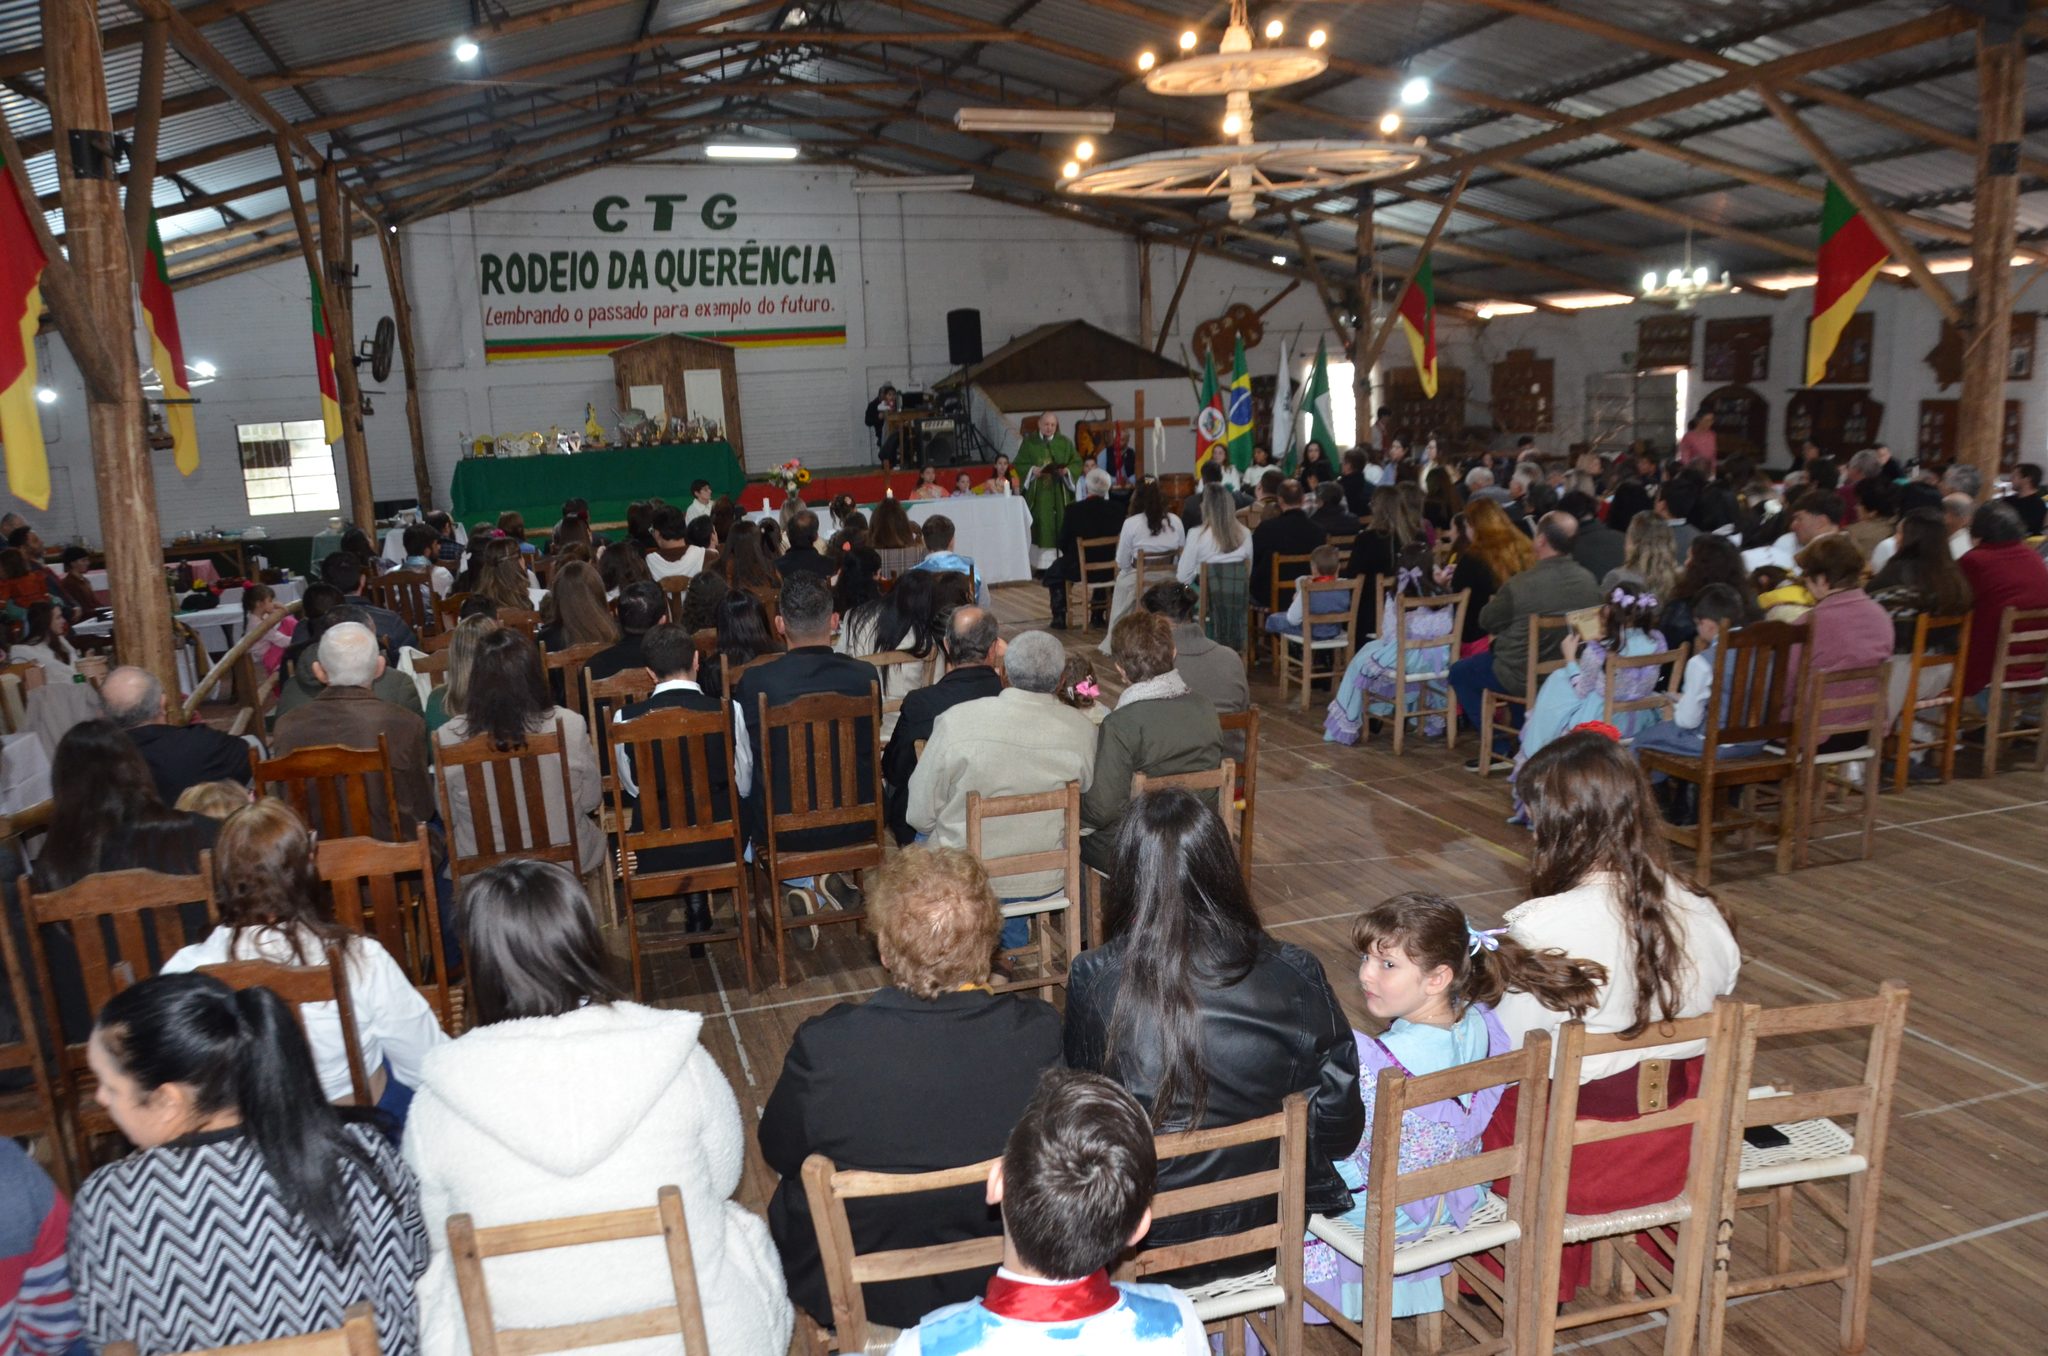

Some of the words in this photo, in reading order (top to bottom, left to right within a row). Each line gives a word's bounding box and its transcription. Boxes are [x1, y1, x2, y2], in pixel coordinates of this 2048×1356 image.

[481, 251, 598, 295] RODEIO
[608, 250, 648, 289] DA
[655, 240, 835, 292] QUERÊNCIA
[485, 304, 568, 327] Lembrando
[574, 309, 584, 322] o
[588, 301, 648, 328] passado
[653, 303, 689, 326] para
[694, 296, 751, 323] exemplo
[757, 295, 776, 314] do
[780, 294, 835, 314] futuro.
